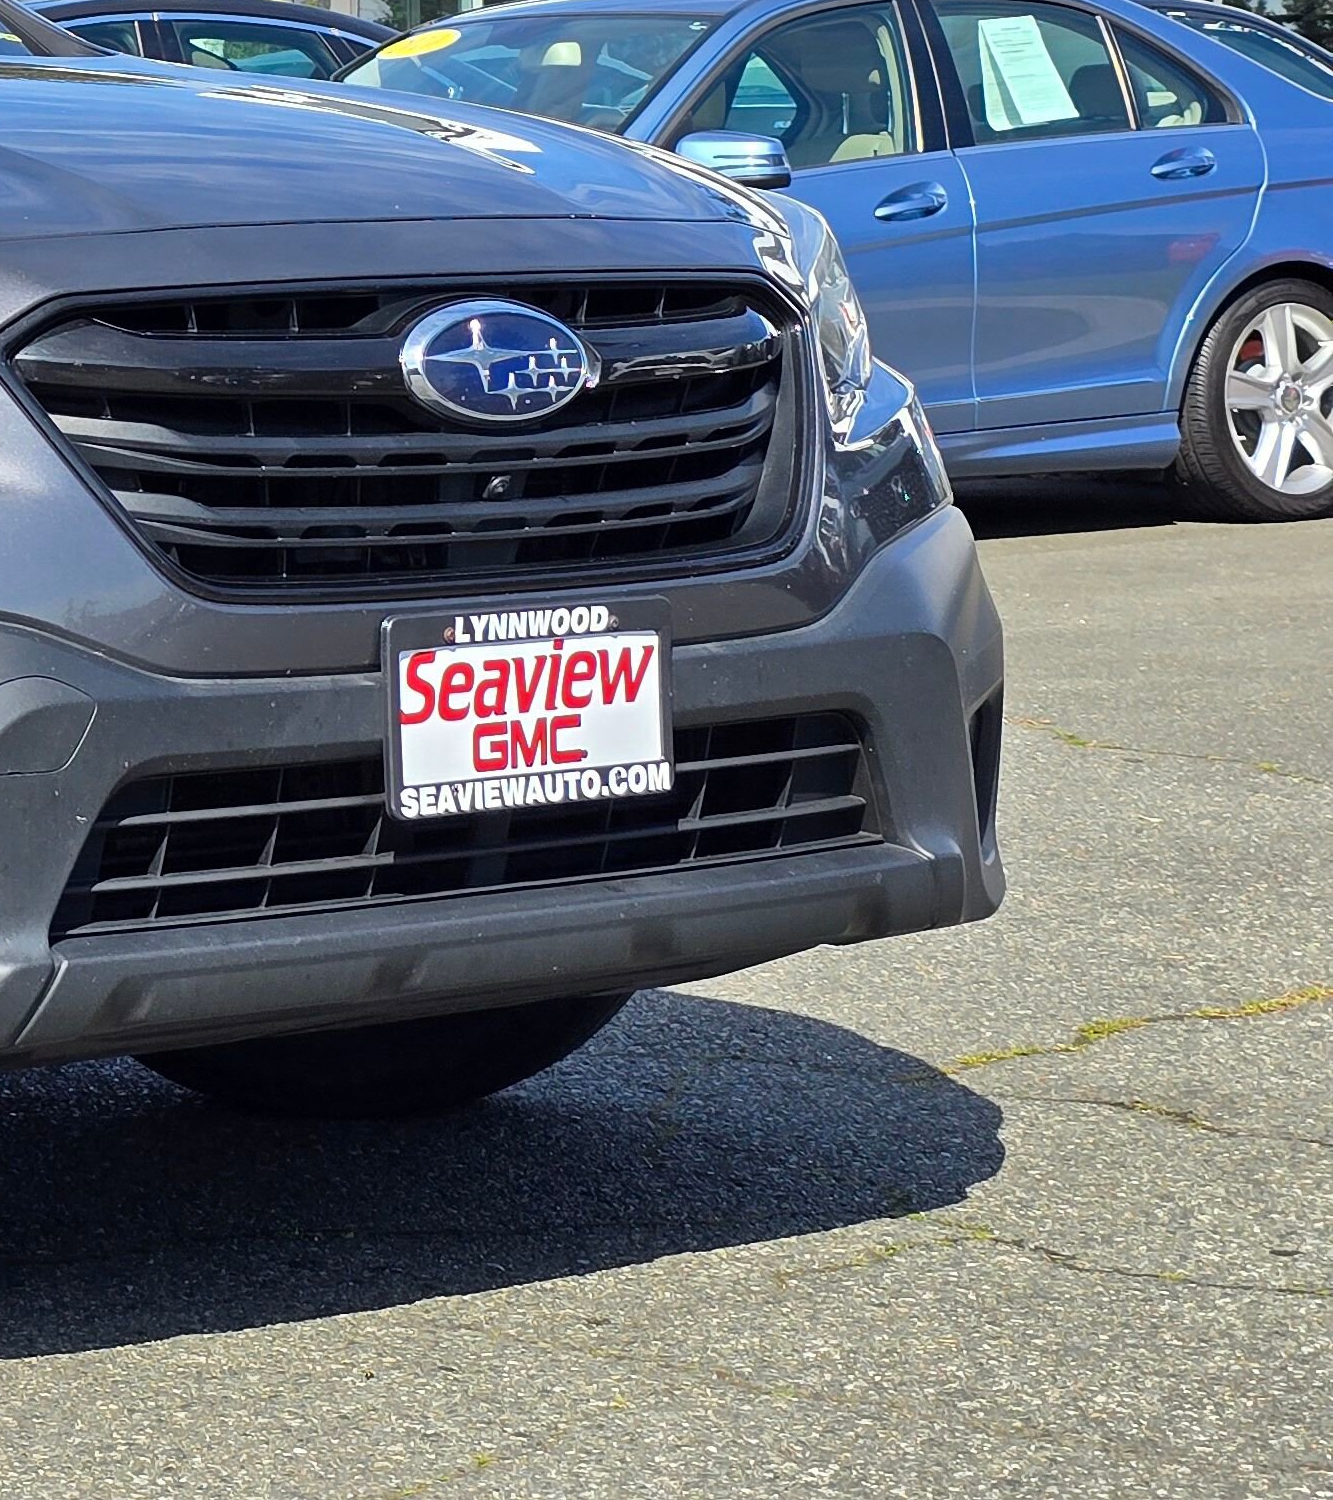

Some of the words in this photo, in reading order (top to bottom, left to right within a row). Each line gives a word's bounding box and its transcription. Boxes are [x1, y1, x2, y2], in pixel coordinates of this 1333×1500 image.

[454, 605, 611, 644] LYNNWOOD
[400, 639, 654, 725] Seaview
[472, 713, 589, 773] GMC
[400, 762, 672, 819] SEAVIEWAUTO.COM
